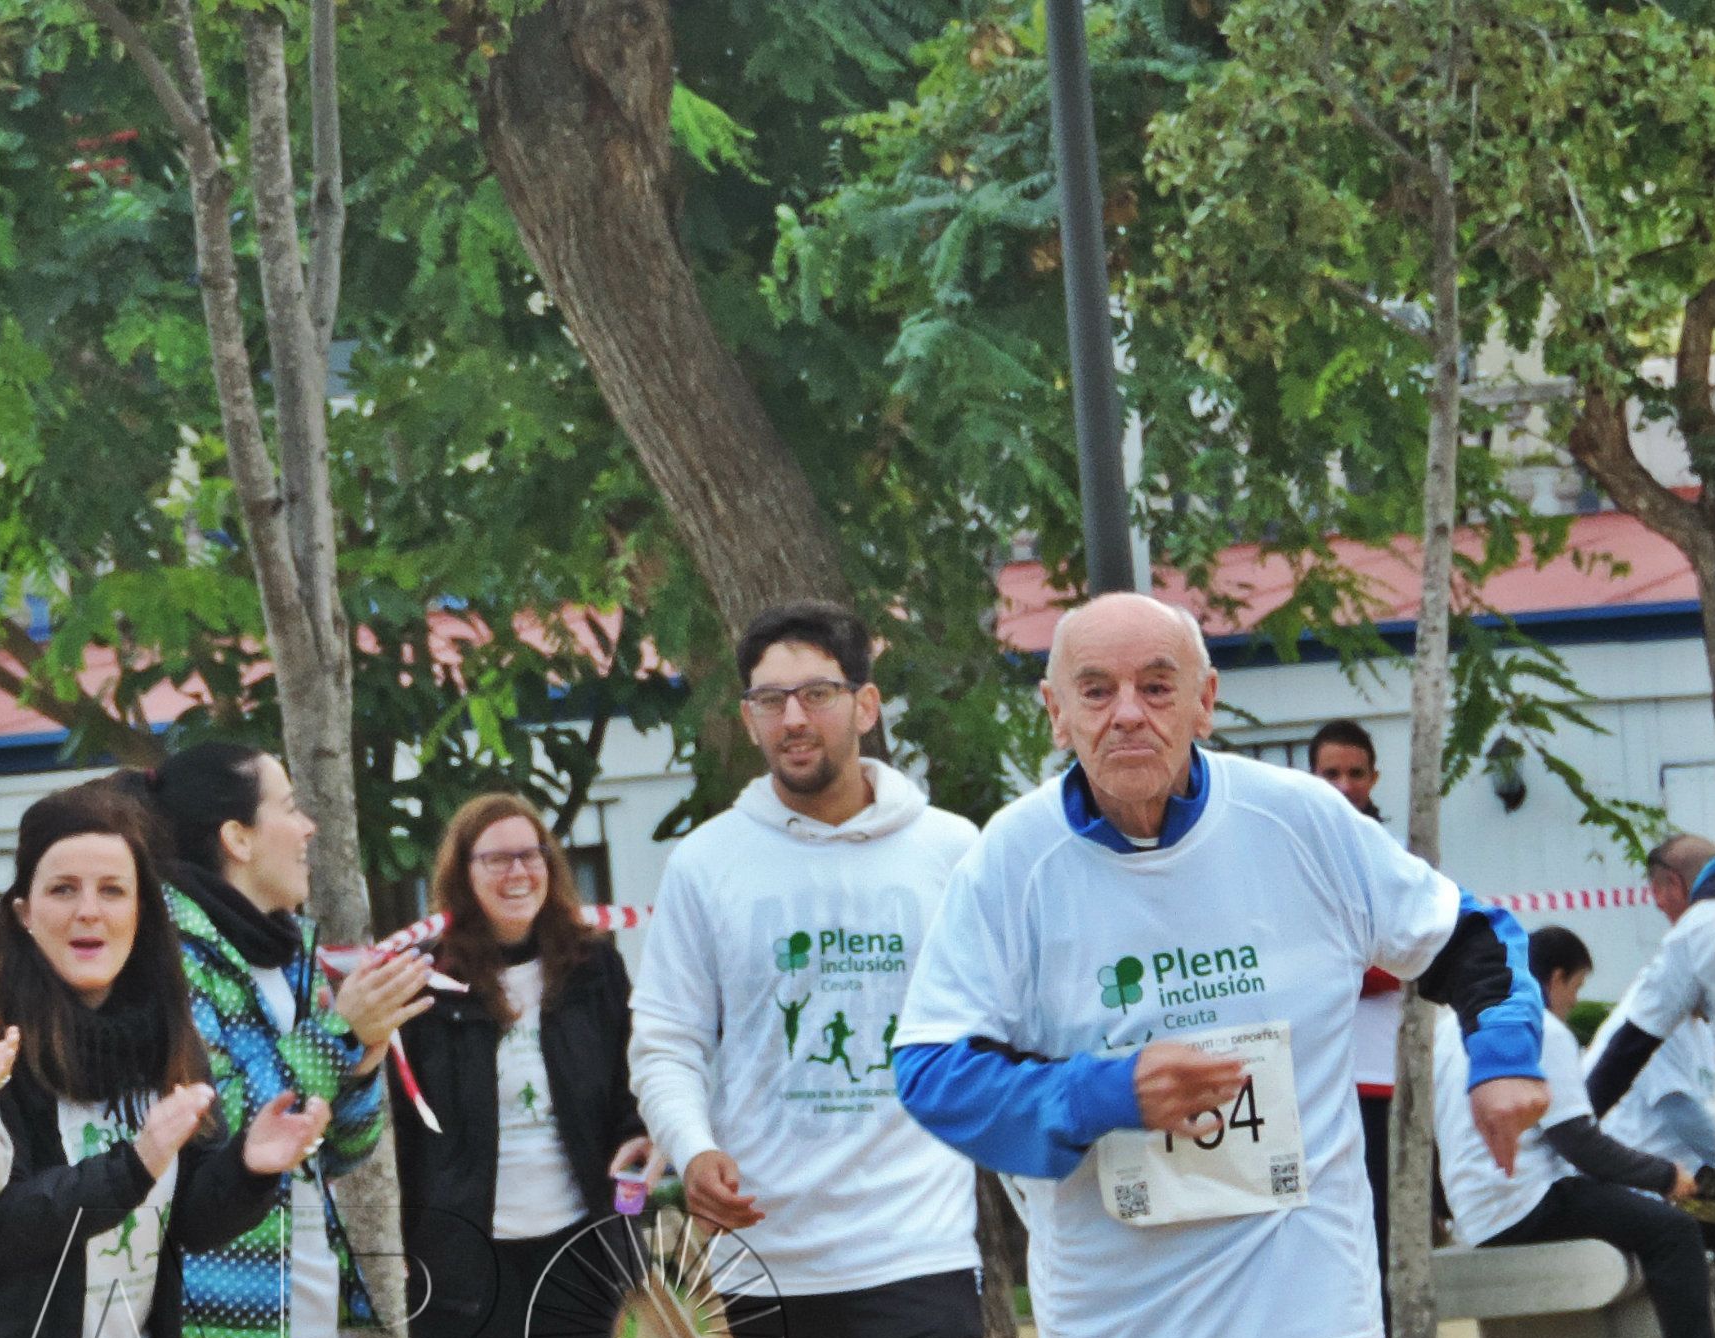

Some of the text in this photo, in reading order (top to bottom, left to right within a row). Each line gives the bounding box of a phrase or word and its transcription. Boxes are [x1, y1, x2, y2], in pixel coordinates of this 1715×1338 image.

[819, 928, 904, 954] Plena
[820, 953, 906, 974] inclusión
[1152, 945, 1259, 985] Plena
[1158, 972, 1266, 1007] inclusión
[1163, 1010, 1218, 1030] Ceuta
[1230, 1029, 1281, 1045] DEPORTES
